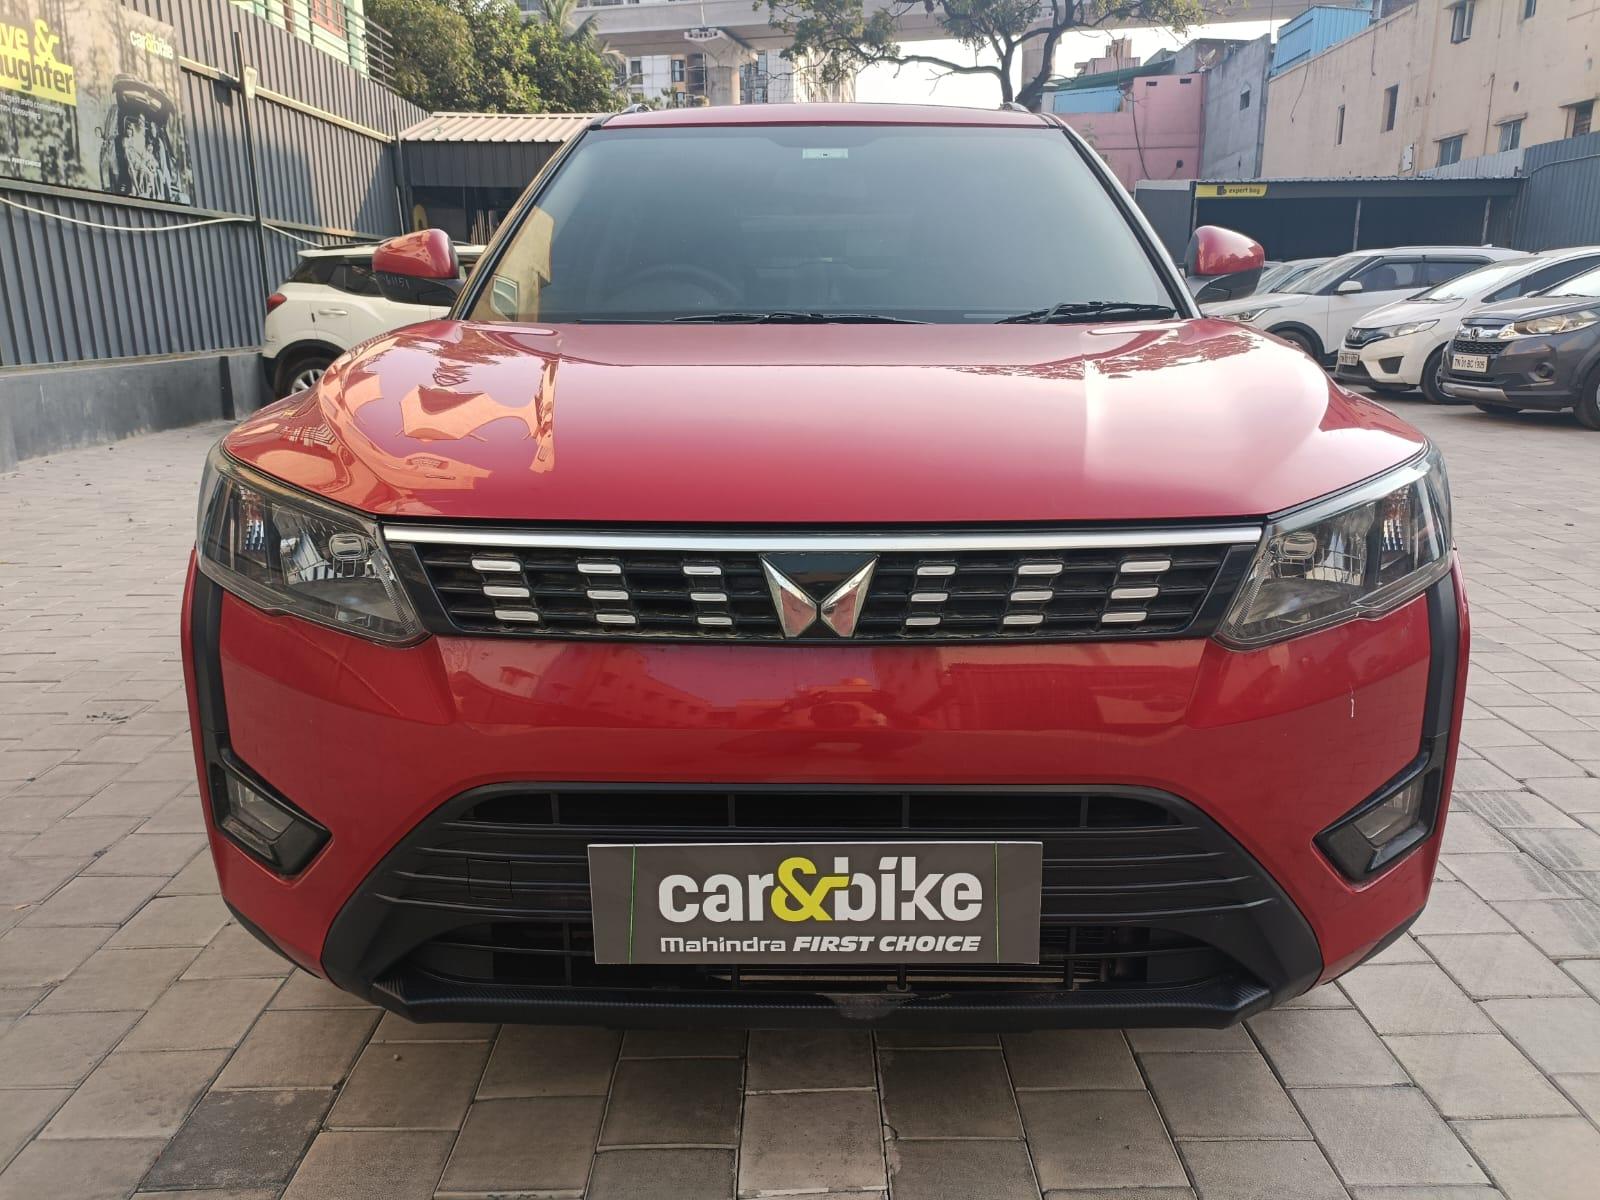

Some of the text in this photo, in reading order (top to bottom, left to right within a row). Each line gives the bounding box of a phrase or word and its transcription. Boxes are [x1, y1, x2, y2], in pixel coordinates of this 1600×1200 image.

[34, 18, 60, 60] &
[658, 856, 983, 923] car&bike
[660, 935, 982, 953] Mahindra FIRST CHOICE
